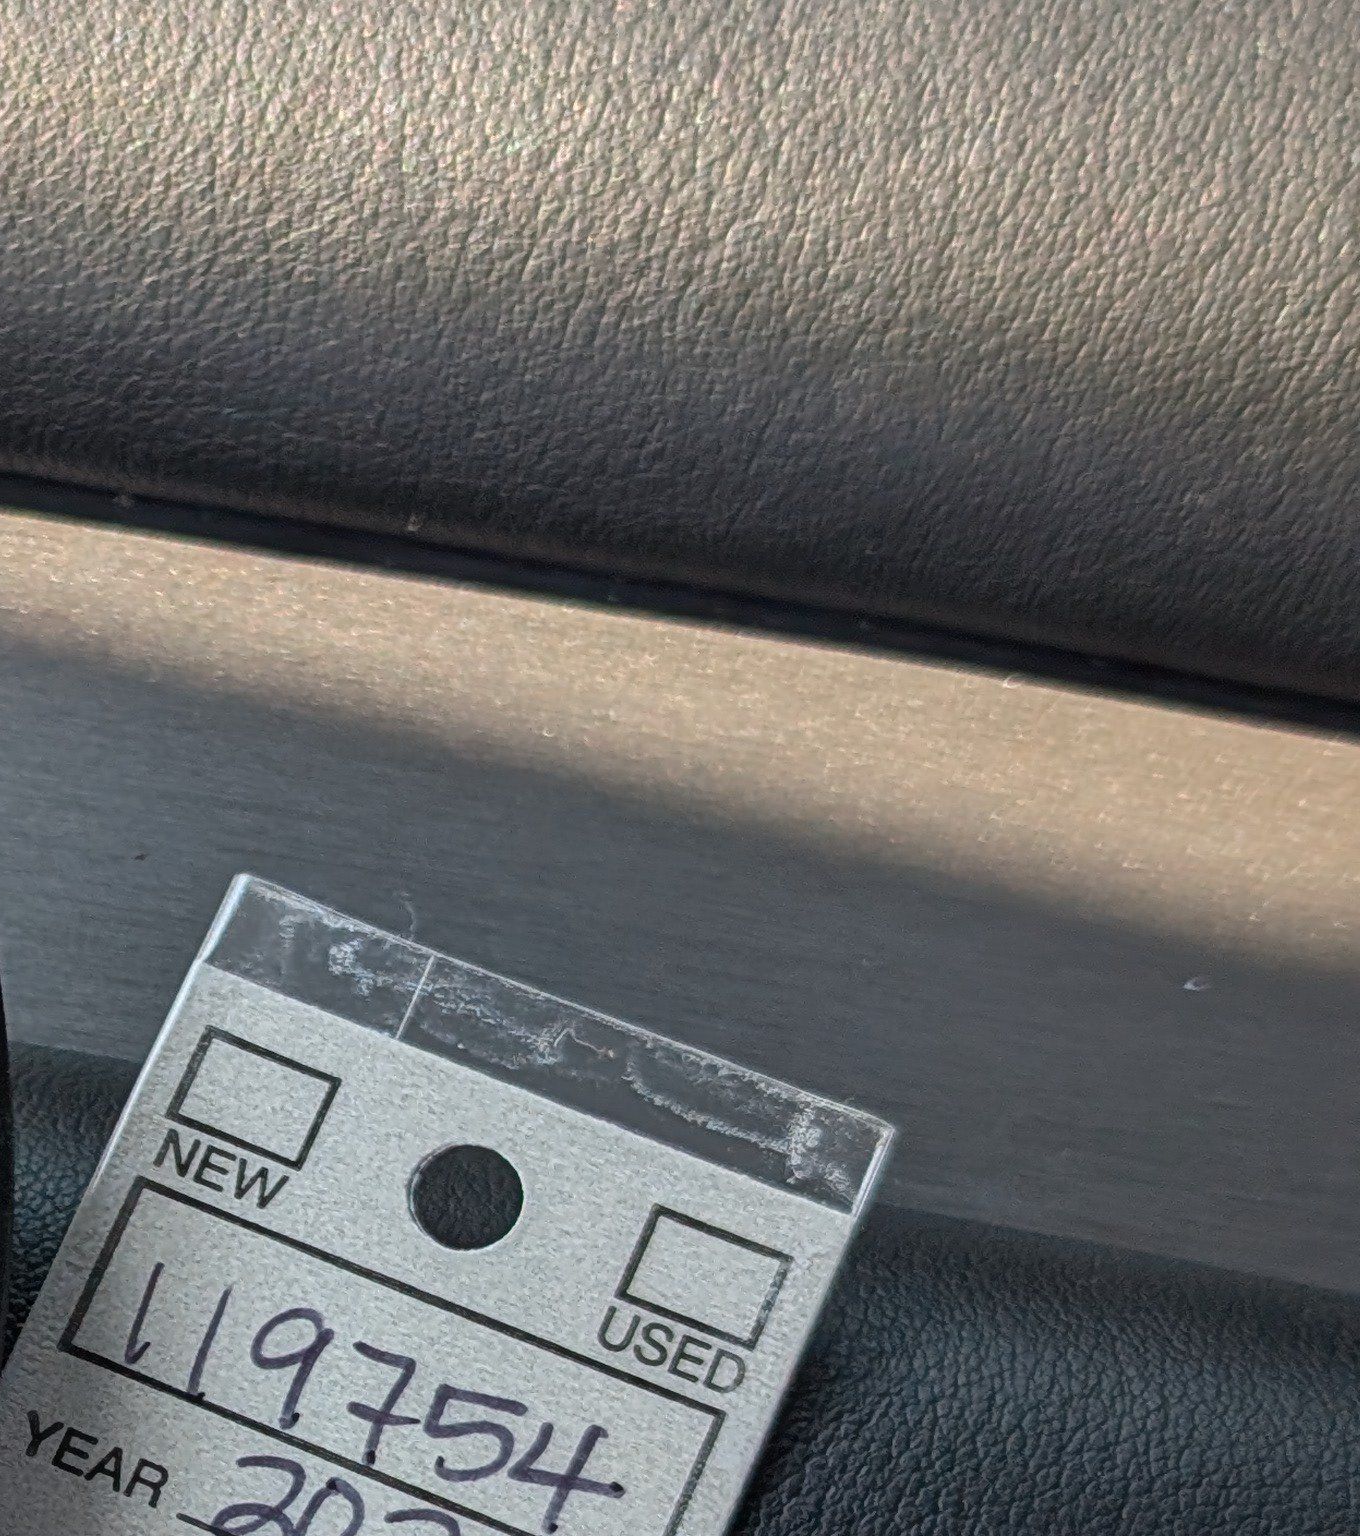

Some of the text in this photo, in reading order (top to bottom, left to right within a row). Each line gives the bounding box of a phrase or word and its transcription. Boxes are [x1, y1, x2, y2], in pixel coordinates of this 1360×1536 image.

[153, 1127, 289, 1209] NEW
[597, 1305, 748, 1394] USED
[123, 1260, 626, 1534] 119754
[26, 1411, 170, 1509] YEAR
